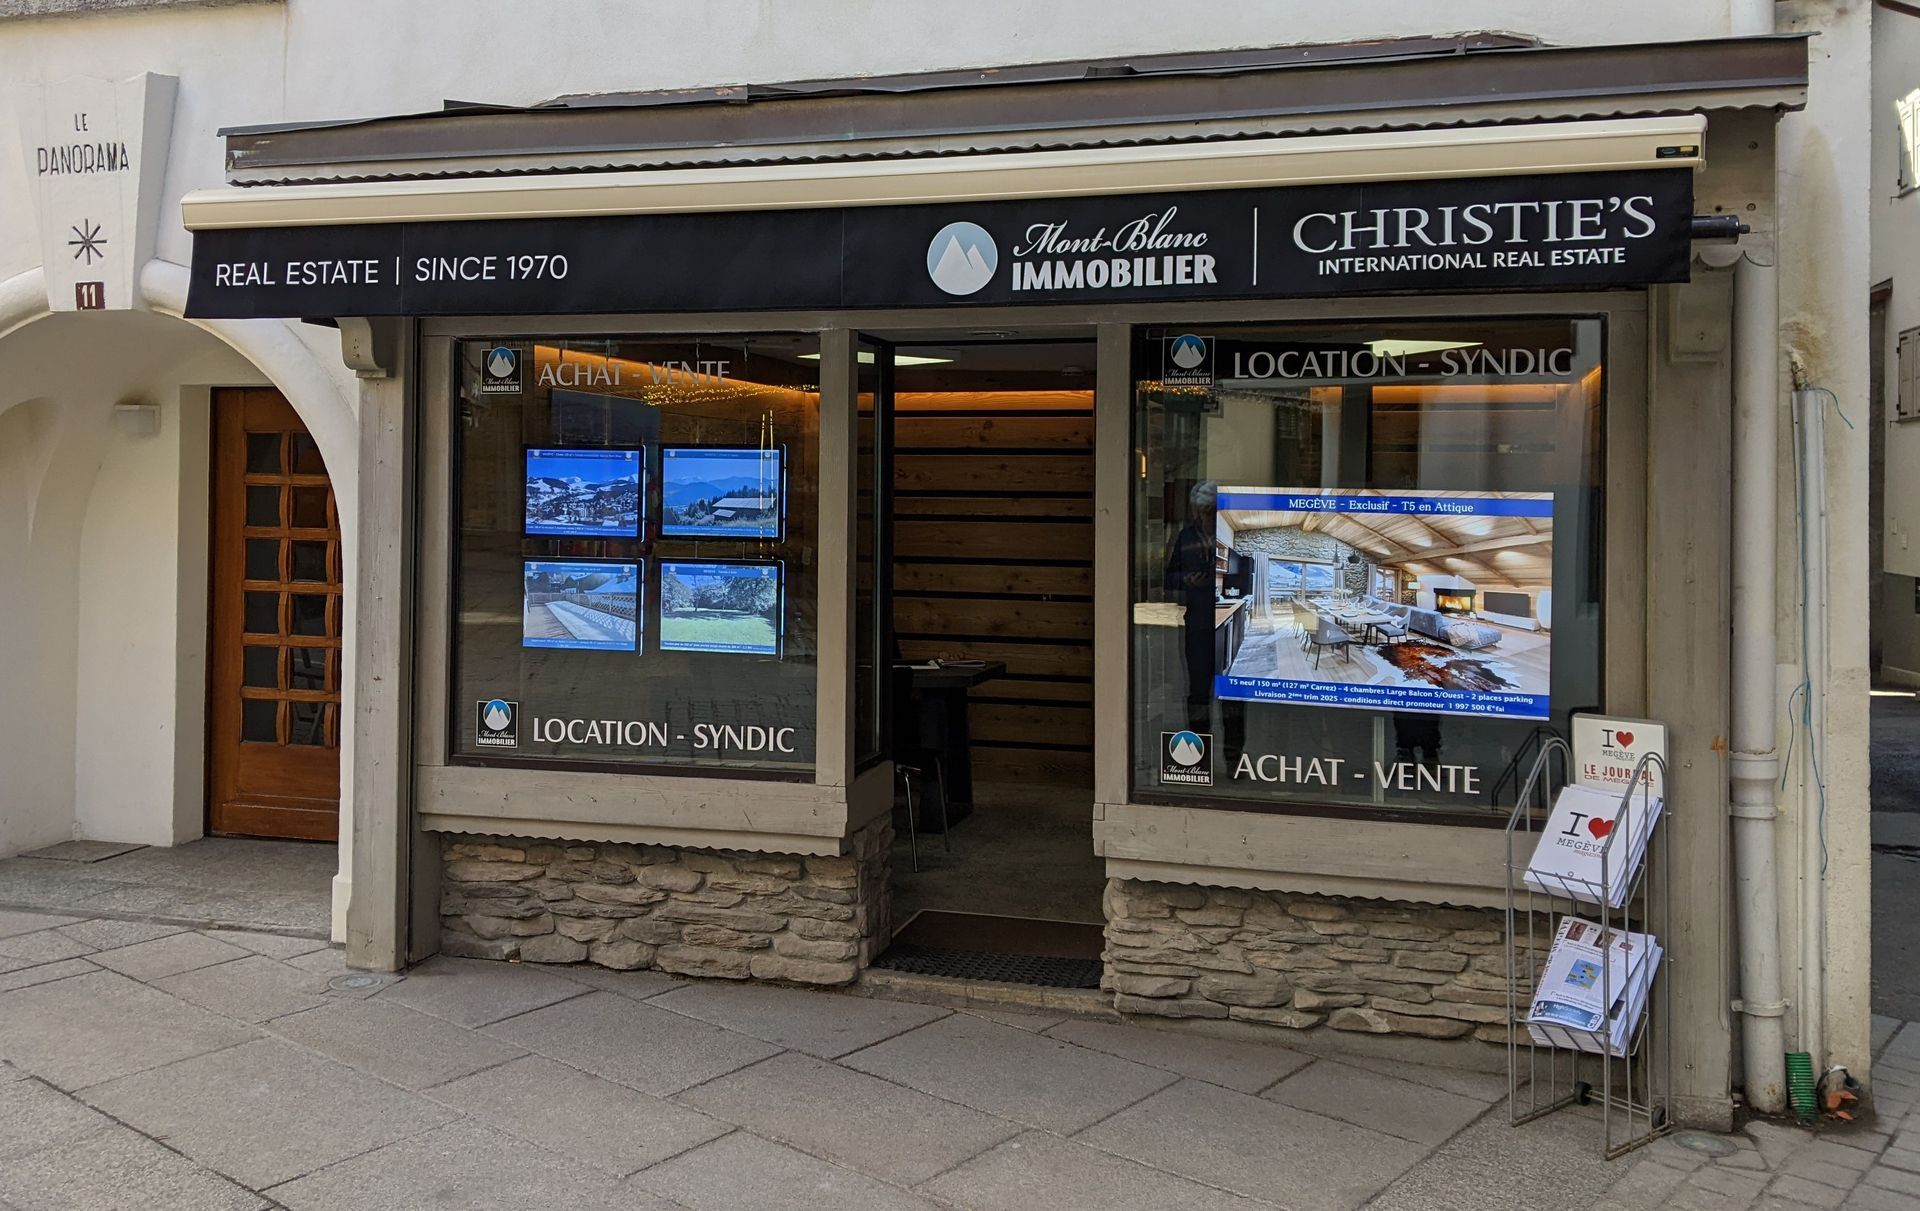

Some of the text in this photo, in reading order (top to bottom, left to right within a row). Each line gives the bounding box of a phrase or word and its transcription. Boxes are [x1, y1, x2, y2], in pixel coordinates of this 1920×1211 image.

[74, 113, 88, 132] LE
[37, 142, 129, 176] PANORAMA
[1013, 206, 1209, 257] Mont-Blanc
[215, 260, 379, 287] REAL ESTATE
[415, 254, 568, 282] SINCE 1970
[1012, 254, 1218, 291] IMMOBILIER
[1318, 247, 1627, 276] INTERNATIONAL REAL ESTATE
[81, 284, 97, 308] 11
[538, 361, 625, 386] ACHAT
[648, 360, 730, 386] VENTE
[1233, 350, 1407, 378] LOCATION
[1440, 348, 1573, 376] SYNDIC
[1164, 377, 1211, 385] IMMOBILIER
[1289, 496, 1336, 510] MEGÈVE
[1349, 501, 1389, 511] Exclusif
[1401, 502, 1415, 512] T5
[1419, 503, 1431, 512] en
[1434, 502, 1474, 514] Attique
[1254, 690, 1287, 698] Livraison
[1320, 694, 1339, 702] 2025
[1382, 698, 1404, 706] direct
[1405, 701, 1445, 709] promoteur
[1257, 680, 1270, 688] 150
[1310, 684, 1337, 692] Carrez)
[1350, 687, 1385, 695] chambres
[1386, 689, 1407, 697] Large
[1434, 691, 1464, 699] S/Ouest
[1478, 694, 1503, 702] places
[1504, 696, 1534, 705] parking
[478, 738, 516, 746] IMMOBILIER
[532, 717, 668, 747] LOCATION
[694, 723, 796, 753] SYNDIC
[1602, 729, 1614, 748] I
[1163, 773, 1210, 783] IMMOBILIER
[1234, 753, 1345, 786] ACHAT
[1374, 761, 1480, 795] VENTE
[1584, 763, 1597, 775] LE
[1602, 777, 1655, 788] MEGVE
[1562, 811, 1588, 837] I
